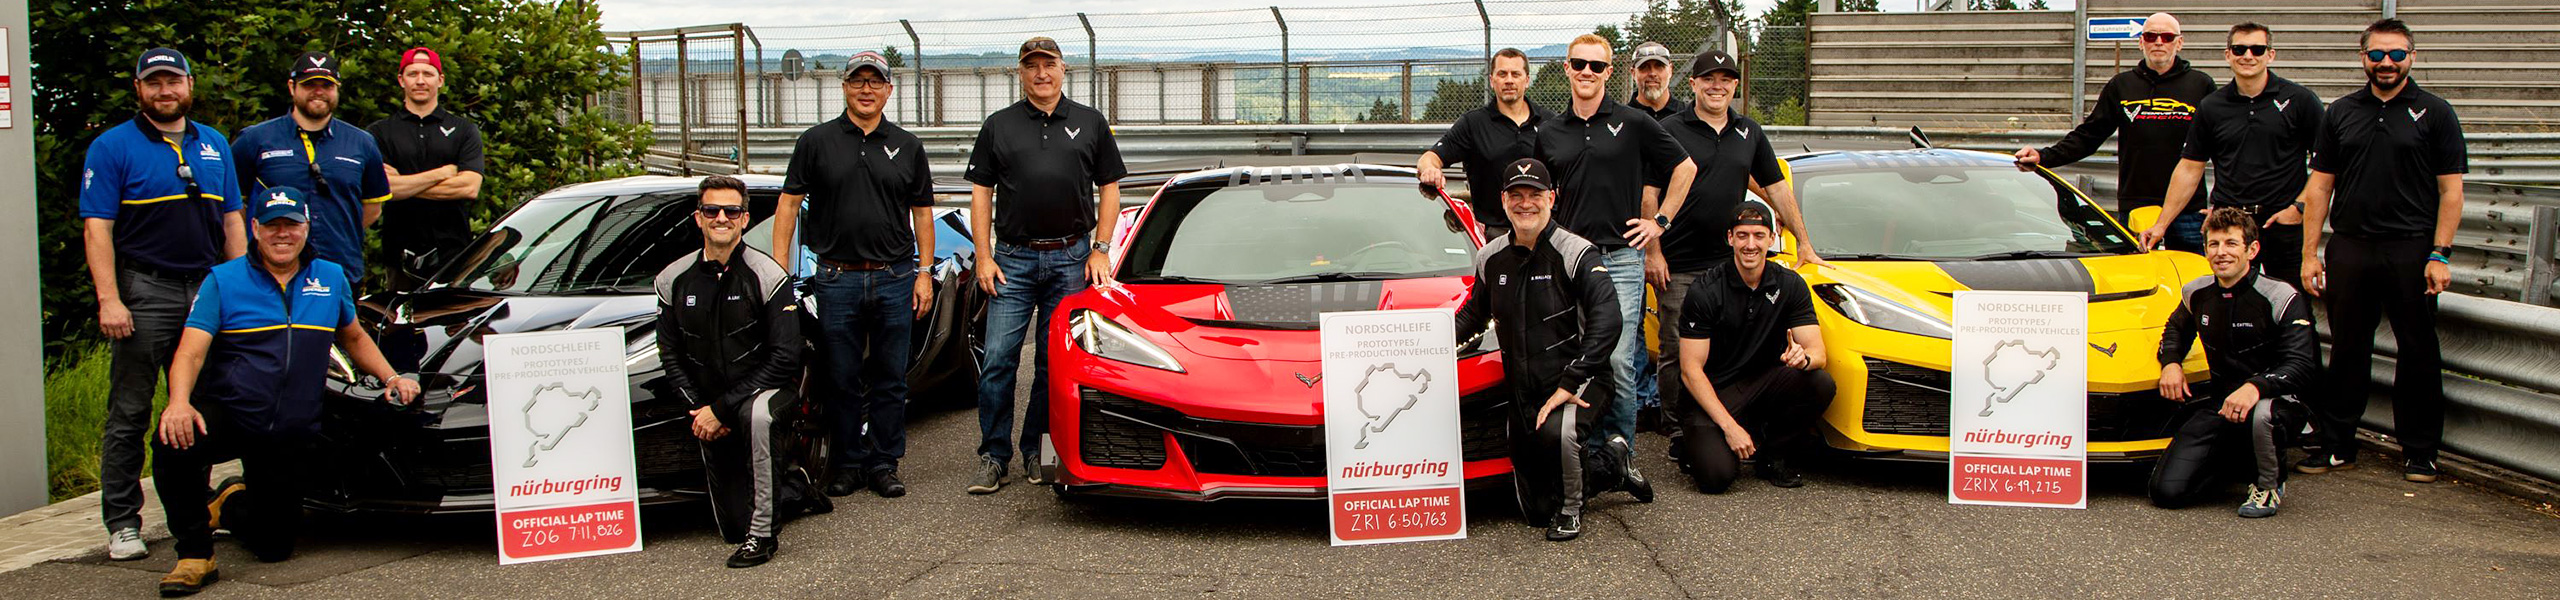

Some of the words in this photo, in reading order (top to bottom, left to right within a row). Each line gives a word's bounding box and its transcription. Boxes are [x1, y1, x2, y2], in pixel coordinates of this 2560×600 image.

[1977, 303, 2064, 313] NORDSCHLEIFE
[1345, 322, 1432, 335] NORDSCHLEIFE
[1988, 317, 2046, 326] PROTOTYPES
[1960, 325, 2037, 335] PRE-PRODUCTION
[2039, 327, 2080, 336] VEHICLES
[511, 341, 601, 356] NORDSCHLEIFE
[1357, 339, 1415, 349] PROTOTYPES
[1329, 349, 1407, 359] PRE-PRODUCTION
[1409, 347, 1450, 356] VEHICLES
[524, 358, 584, 369] PROTOTYPES
[494, 368, 576, 380] PRE-PRODUCTION
[577, 364, 620, 375] VEHICLES
[1964, 429, 2073, 450] nürburgring
[1341, 459, 1449, 479] nürburgring
[1964, 463, 2017, 475] OFFICIAL
[2019, 465, 2041, 476] LAP
[2043, 466, 2072, 477] TIME
[510, 474, 622, 497] nürburgring
[2004, 479, 2062, 494] 6:49,275
[1344, 499, 1397, 511] OFFICIAL
[1399, 498, 1421, 508] LAP
[1422, 496, 1450, 506] TIME
[513, 515, 568, 530] OFFICIAL
[570, 513, 594, 524] LAP
[595, 510, 624, 522] TIME
[1388, 511, 1447, 529] 6:50,763
[521, 529, 560, 548] Z06
[568, 523, 623, 541] 7:11,826
